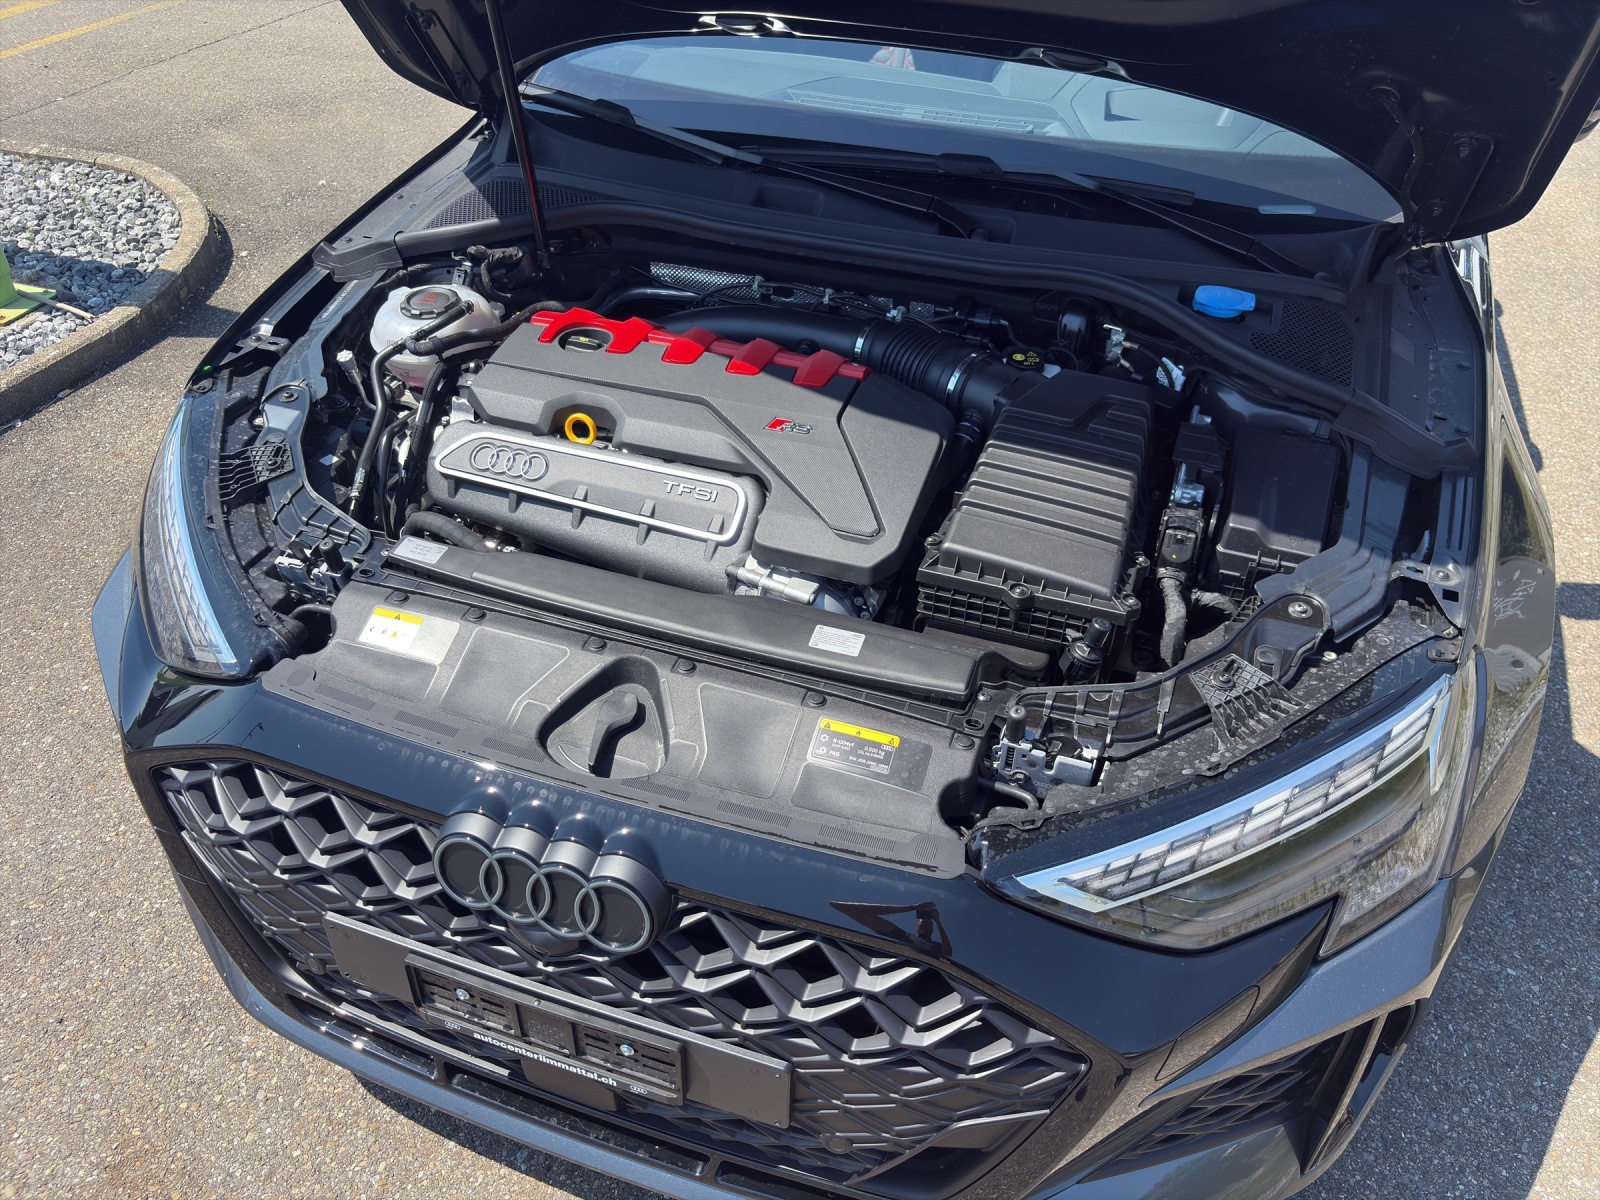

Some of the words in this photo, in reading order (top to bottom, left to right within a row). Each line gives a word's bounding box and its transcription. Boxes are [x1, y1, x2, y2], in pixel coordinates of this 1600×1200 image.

[767, 417, 813, 435] RS
[663, 480, 719, 503] TFSI
[473, 1031, 617, 1087] autocenterlimmattal.ch
